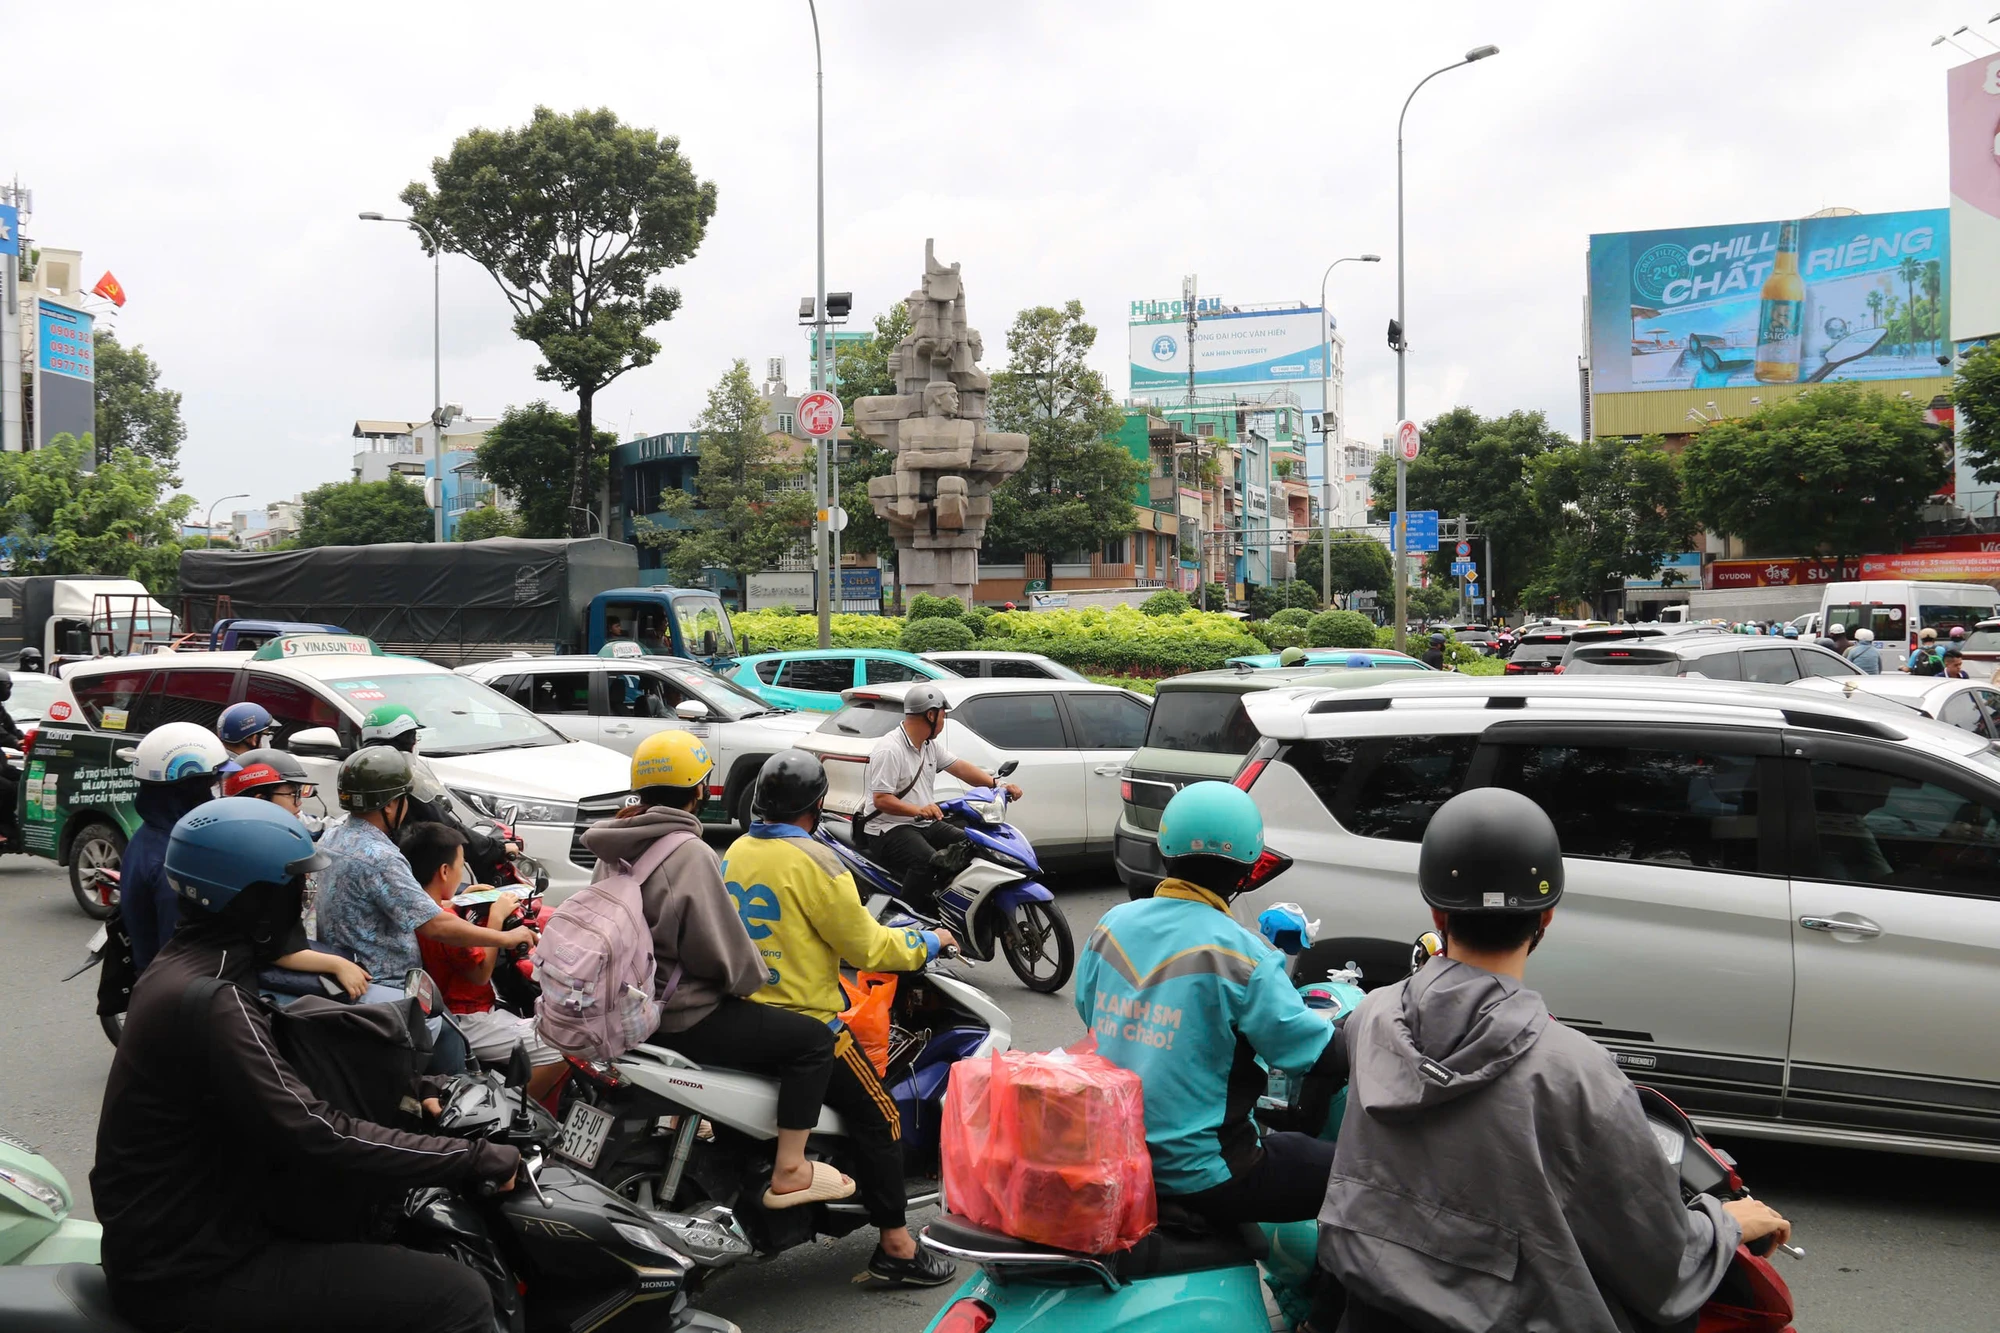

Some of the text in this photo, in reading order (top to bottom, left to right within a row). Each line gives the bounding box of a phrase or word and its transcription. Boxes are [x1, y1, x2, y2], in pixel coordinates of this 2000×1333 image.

[1687, 231, 1776, 266] CHILL
[1806, 226, 1934, 275] RIÊNG
[1662, 256, 1772, 305] CHẤT
[51, 324, 76, 340] 0908
[51, 341, 76, 356] 0933
[51, 357, 75, 371] 0977
[74, 768, 86, 780] HỖ
[86, 768, 100, 778] TRỢ
[108, 780, 133, 789] THÔNG
[69, 792, 80, 804] HỖ
[80, 794, 94, 805] TRỢ
[109, 793, 132, 804] THIỆN
[1096, 990, 1182, 1029] XANH SM
[1096, 1014, 1118, 1038] xin
[1628, 1056, 1654, 1066] FRIENDLY
[668, 1078, 704, 1090] HONDA
[572, 1108, 604, 1138] 59-U1
[641, 1280, 676, 1288] HONDA
